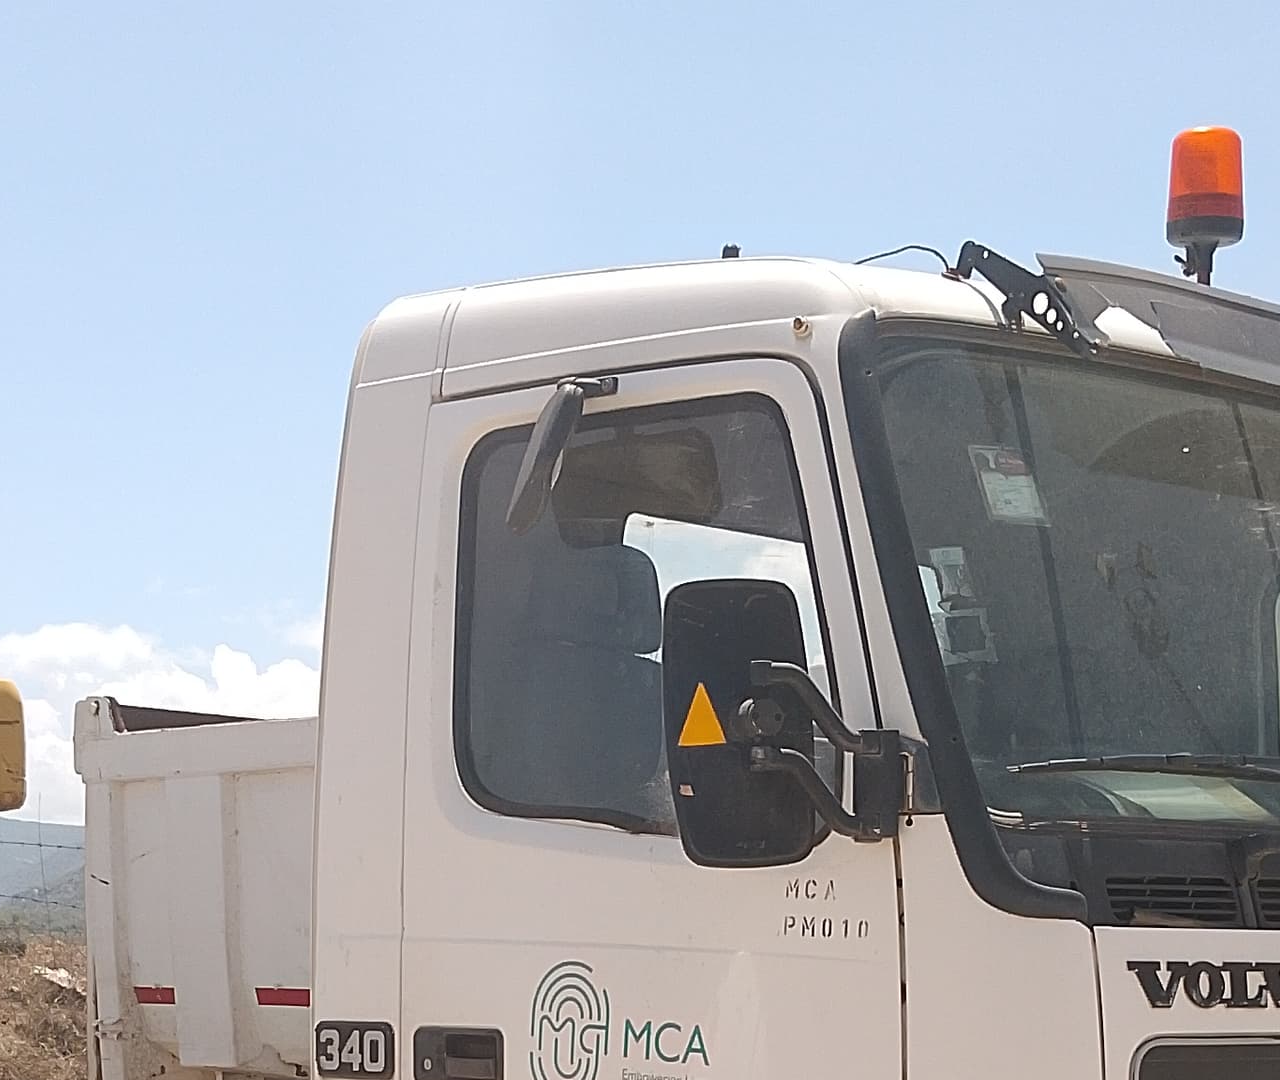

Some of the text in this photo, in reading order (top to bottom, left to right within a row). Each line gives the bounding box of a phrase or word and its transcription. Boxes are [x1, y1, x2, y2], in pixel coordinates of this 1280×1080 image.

[785, 878, 836, 900] MCA
[319, 1028, 386, 1073] 340
[622, 1018, 710, 1067] MCA
